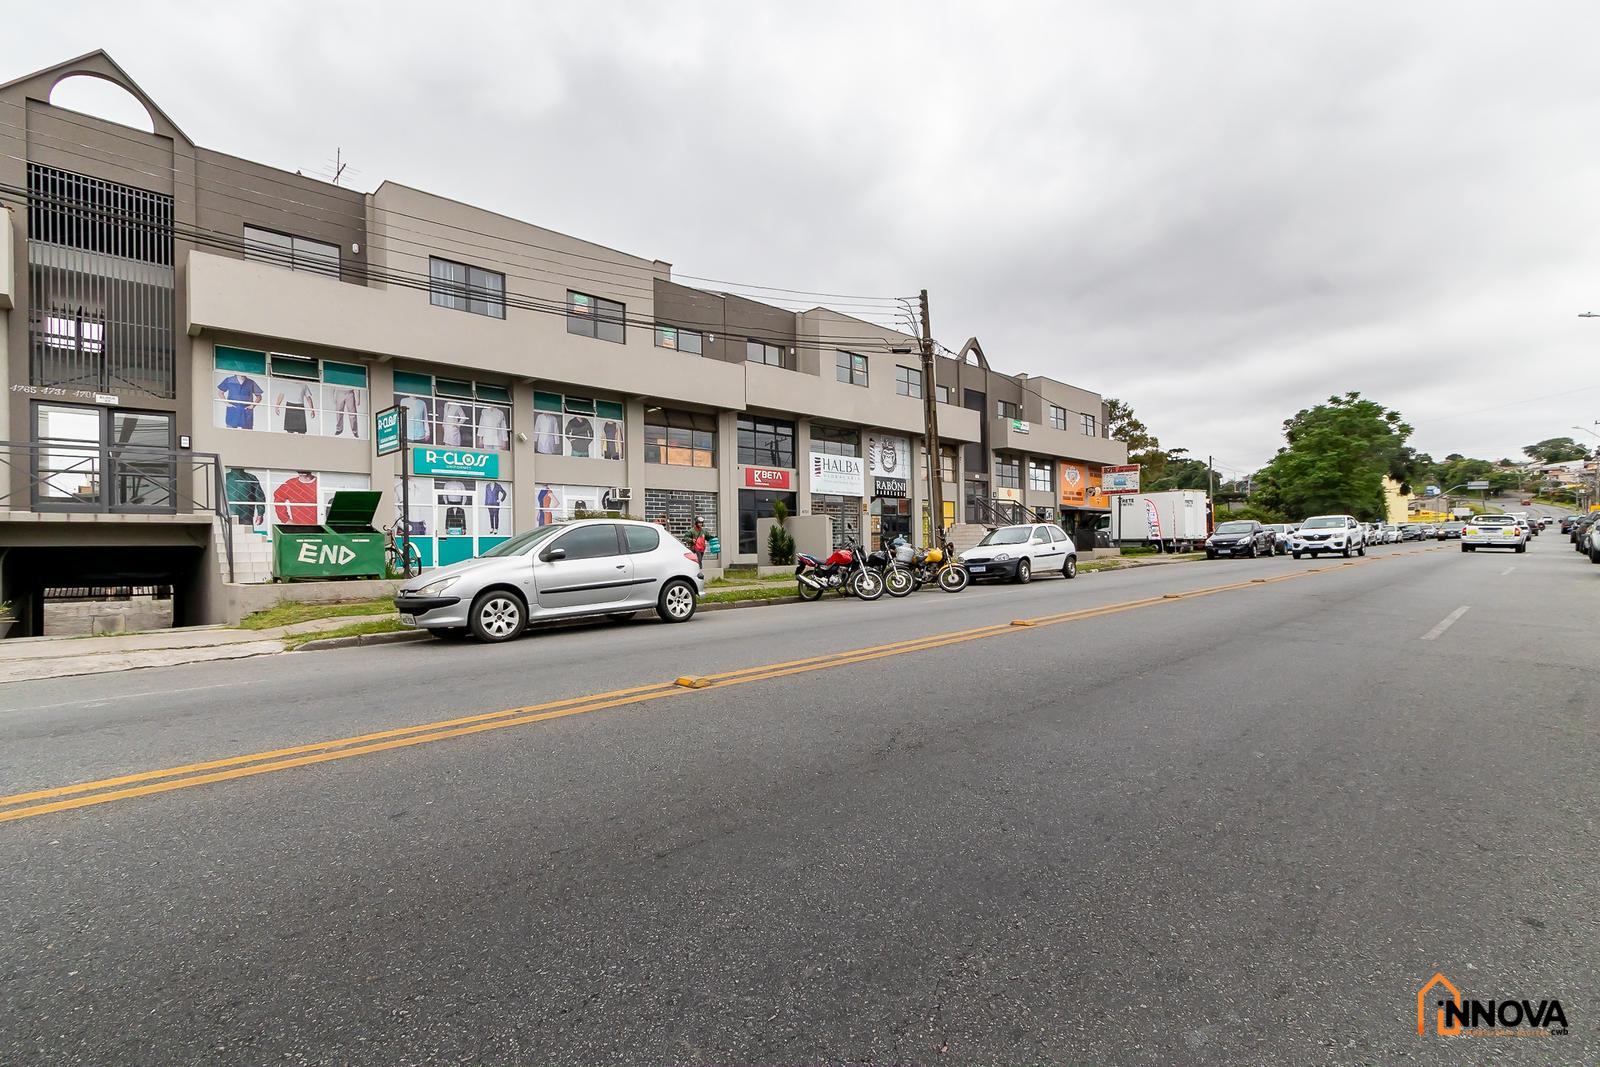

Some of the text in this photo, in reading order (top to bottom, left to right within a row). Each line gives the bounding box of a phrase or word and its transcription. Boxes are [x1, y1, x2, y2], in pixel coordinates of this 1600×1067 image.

[426, 450, 489, 467] R-CLOSS
[822, 457, 860, 473] HALBA
[876, 479, 906, 491] RABÔNI
[297, 543, 357, 565] END
